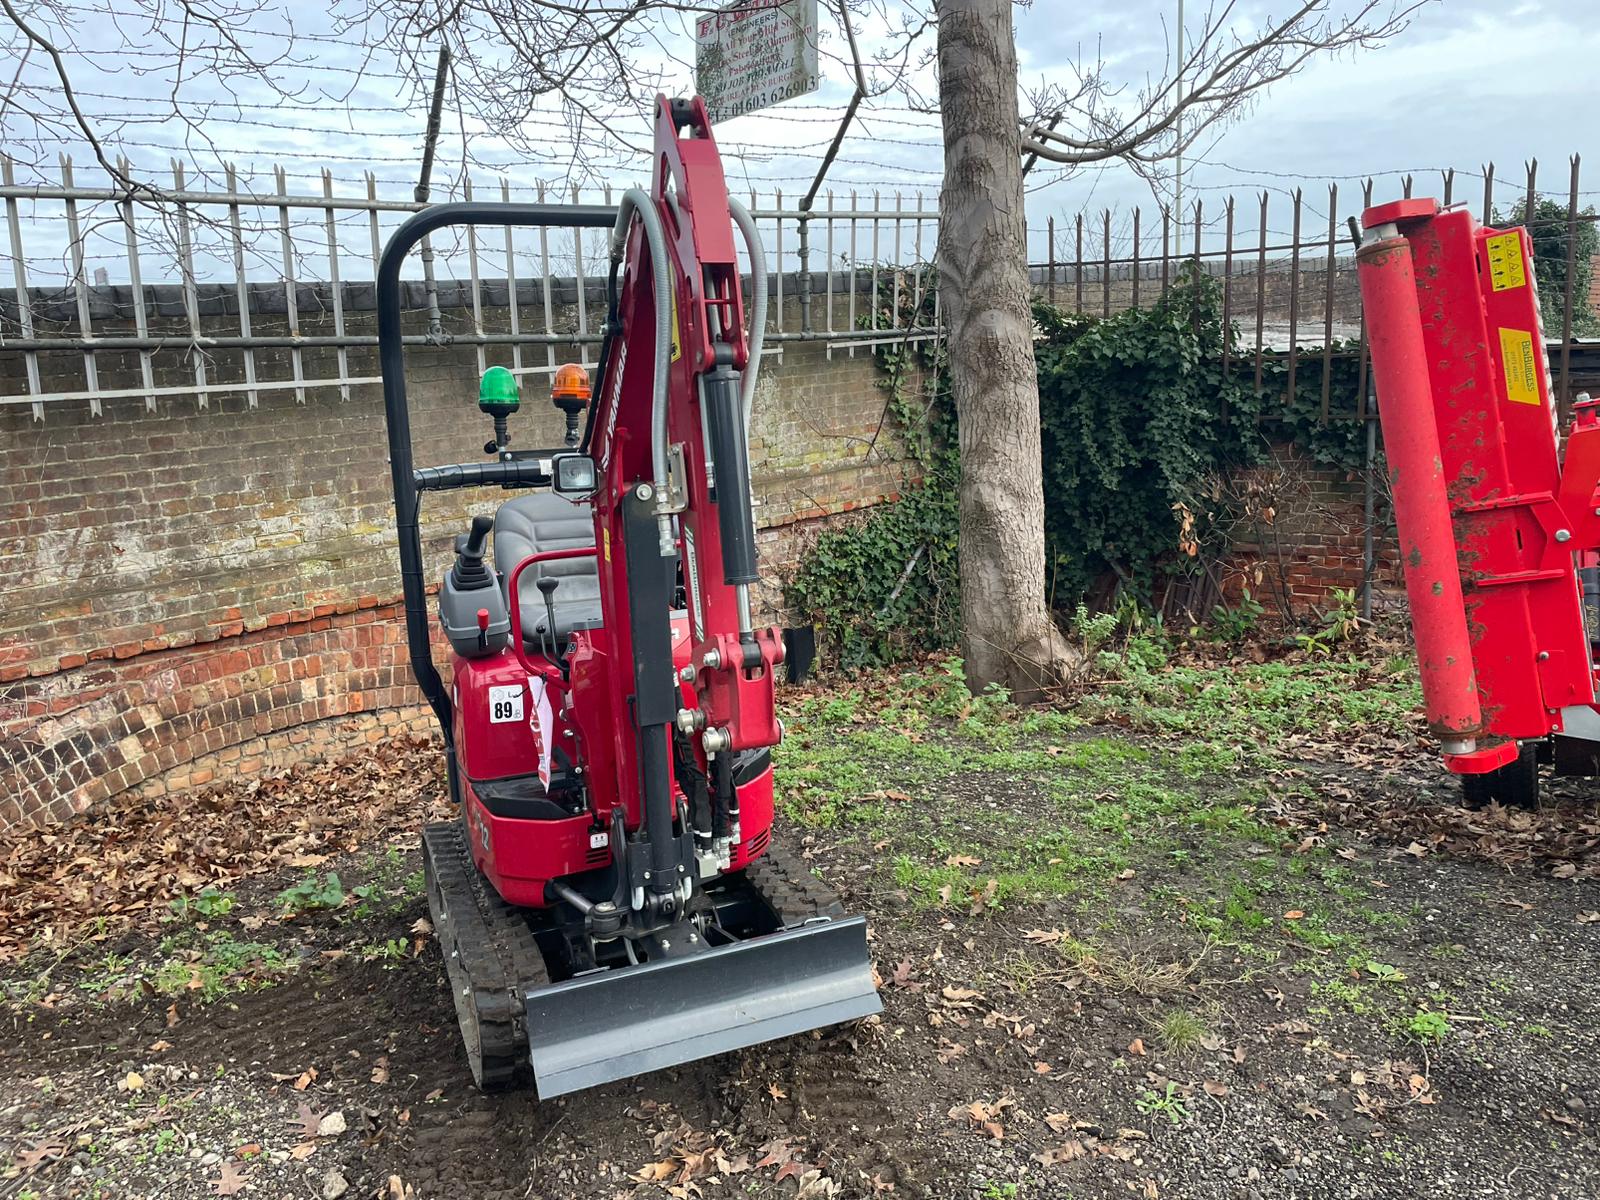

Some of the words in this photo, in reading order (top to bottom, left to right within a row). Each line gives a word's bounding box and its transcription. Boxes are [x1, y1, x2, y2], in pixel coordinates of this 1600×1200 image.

[731, 92, 767, 117] 01603
[770, 75, 816, 103] 626903
[606, 341, 628, 435] YANMAR
[495, 701, 513, 719] 89
